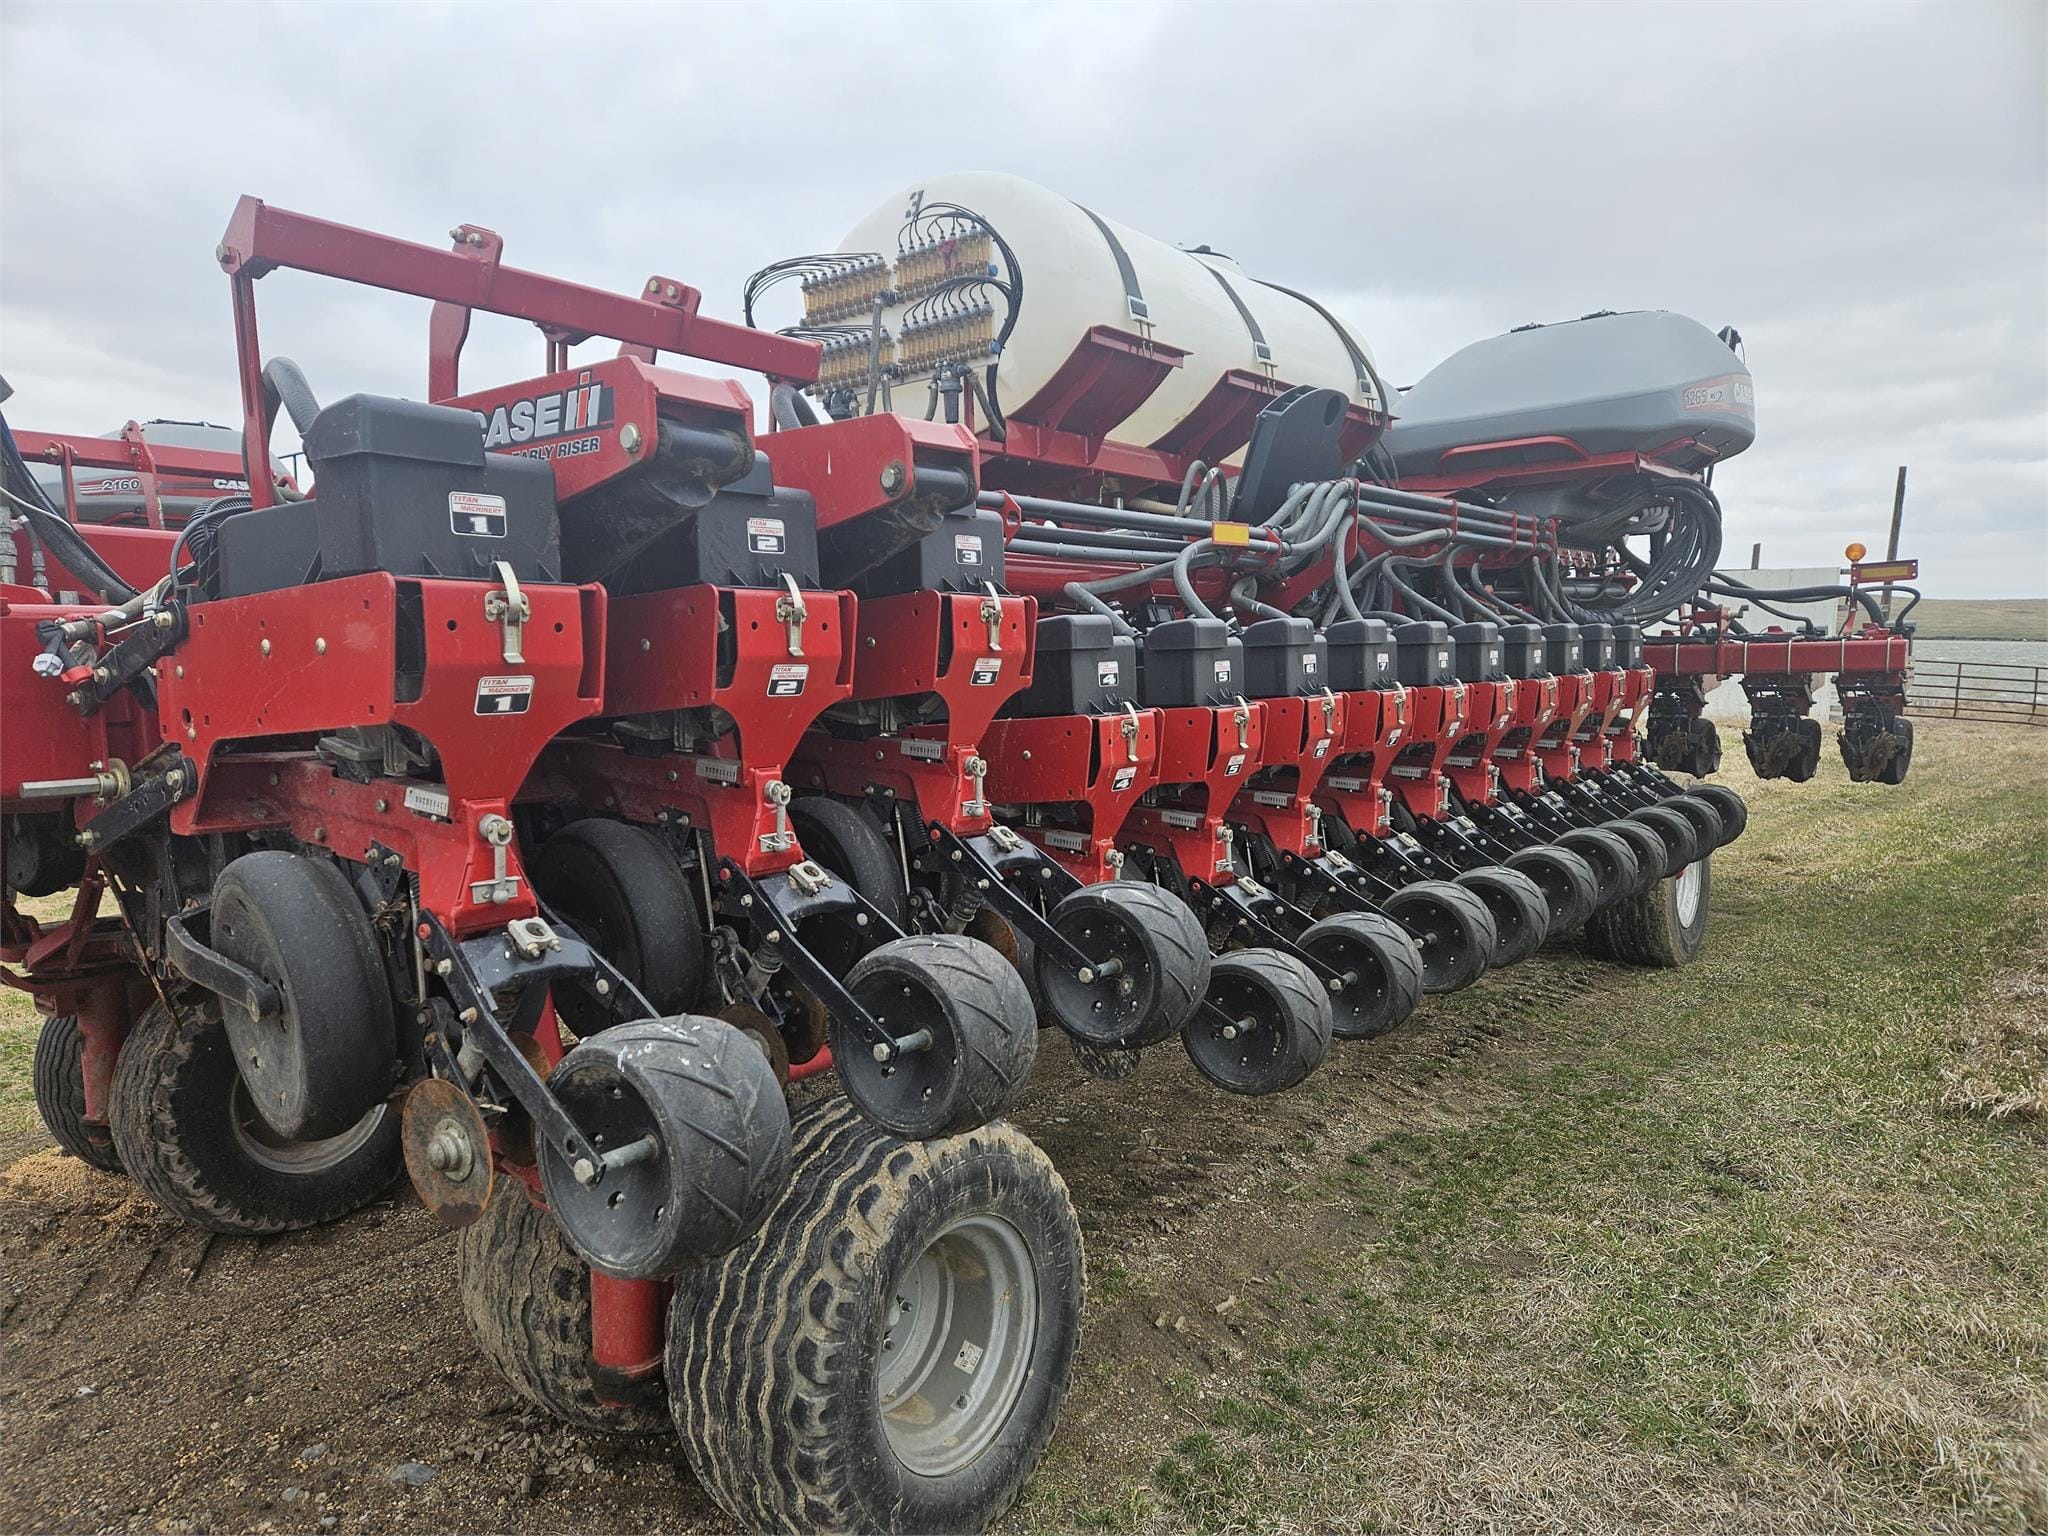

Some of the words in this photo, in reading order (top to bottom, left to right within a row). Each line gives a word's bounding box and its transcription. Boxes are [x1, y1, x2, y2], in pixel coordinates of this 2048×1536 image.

[511, 444, 556, 461] ARLY
[557, 436, 600, 460] RISER
[102, 479, 140, 491] 2160
[213, 479, 251, 491] CAS
[453, 495, 479, 503] TITAN
[470, 516, 492, 534] 1
[757, 536, 778, 551] 2
[962, 550, 978, 563] 3
[1306, 664, 1315, 673] 6
[1379, 662, 1388, 671] 7
[976, 672, 994, 684] 3
[1102, 674, 1116, 685] 4
[1218, 672, 1229, 682] 5
[776, 681, 798, 694] 2
[493, 696, 513, 712] 1
[1228, 765, 1239, 774] 5
[1115, 778, 1130, 788] 4
